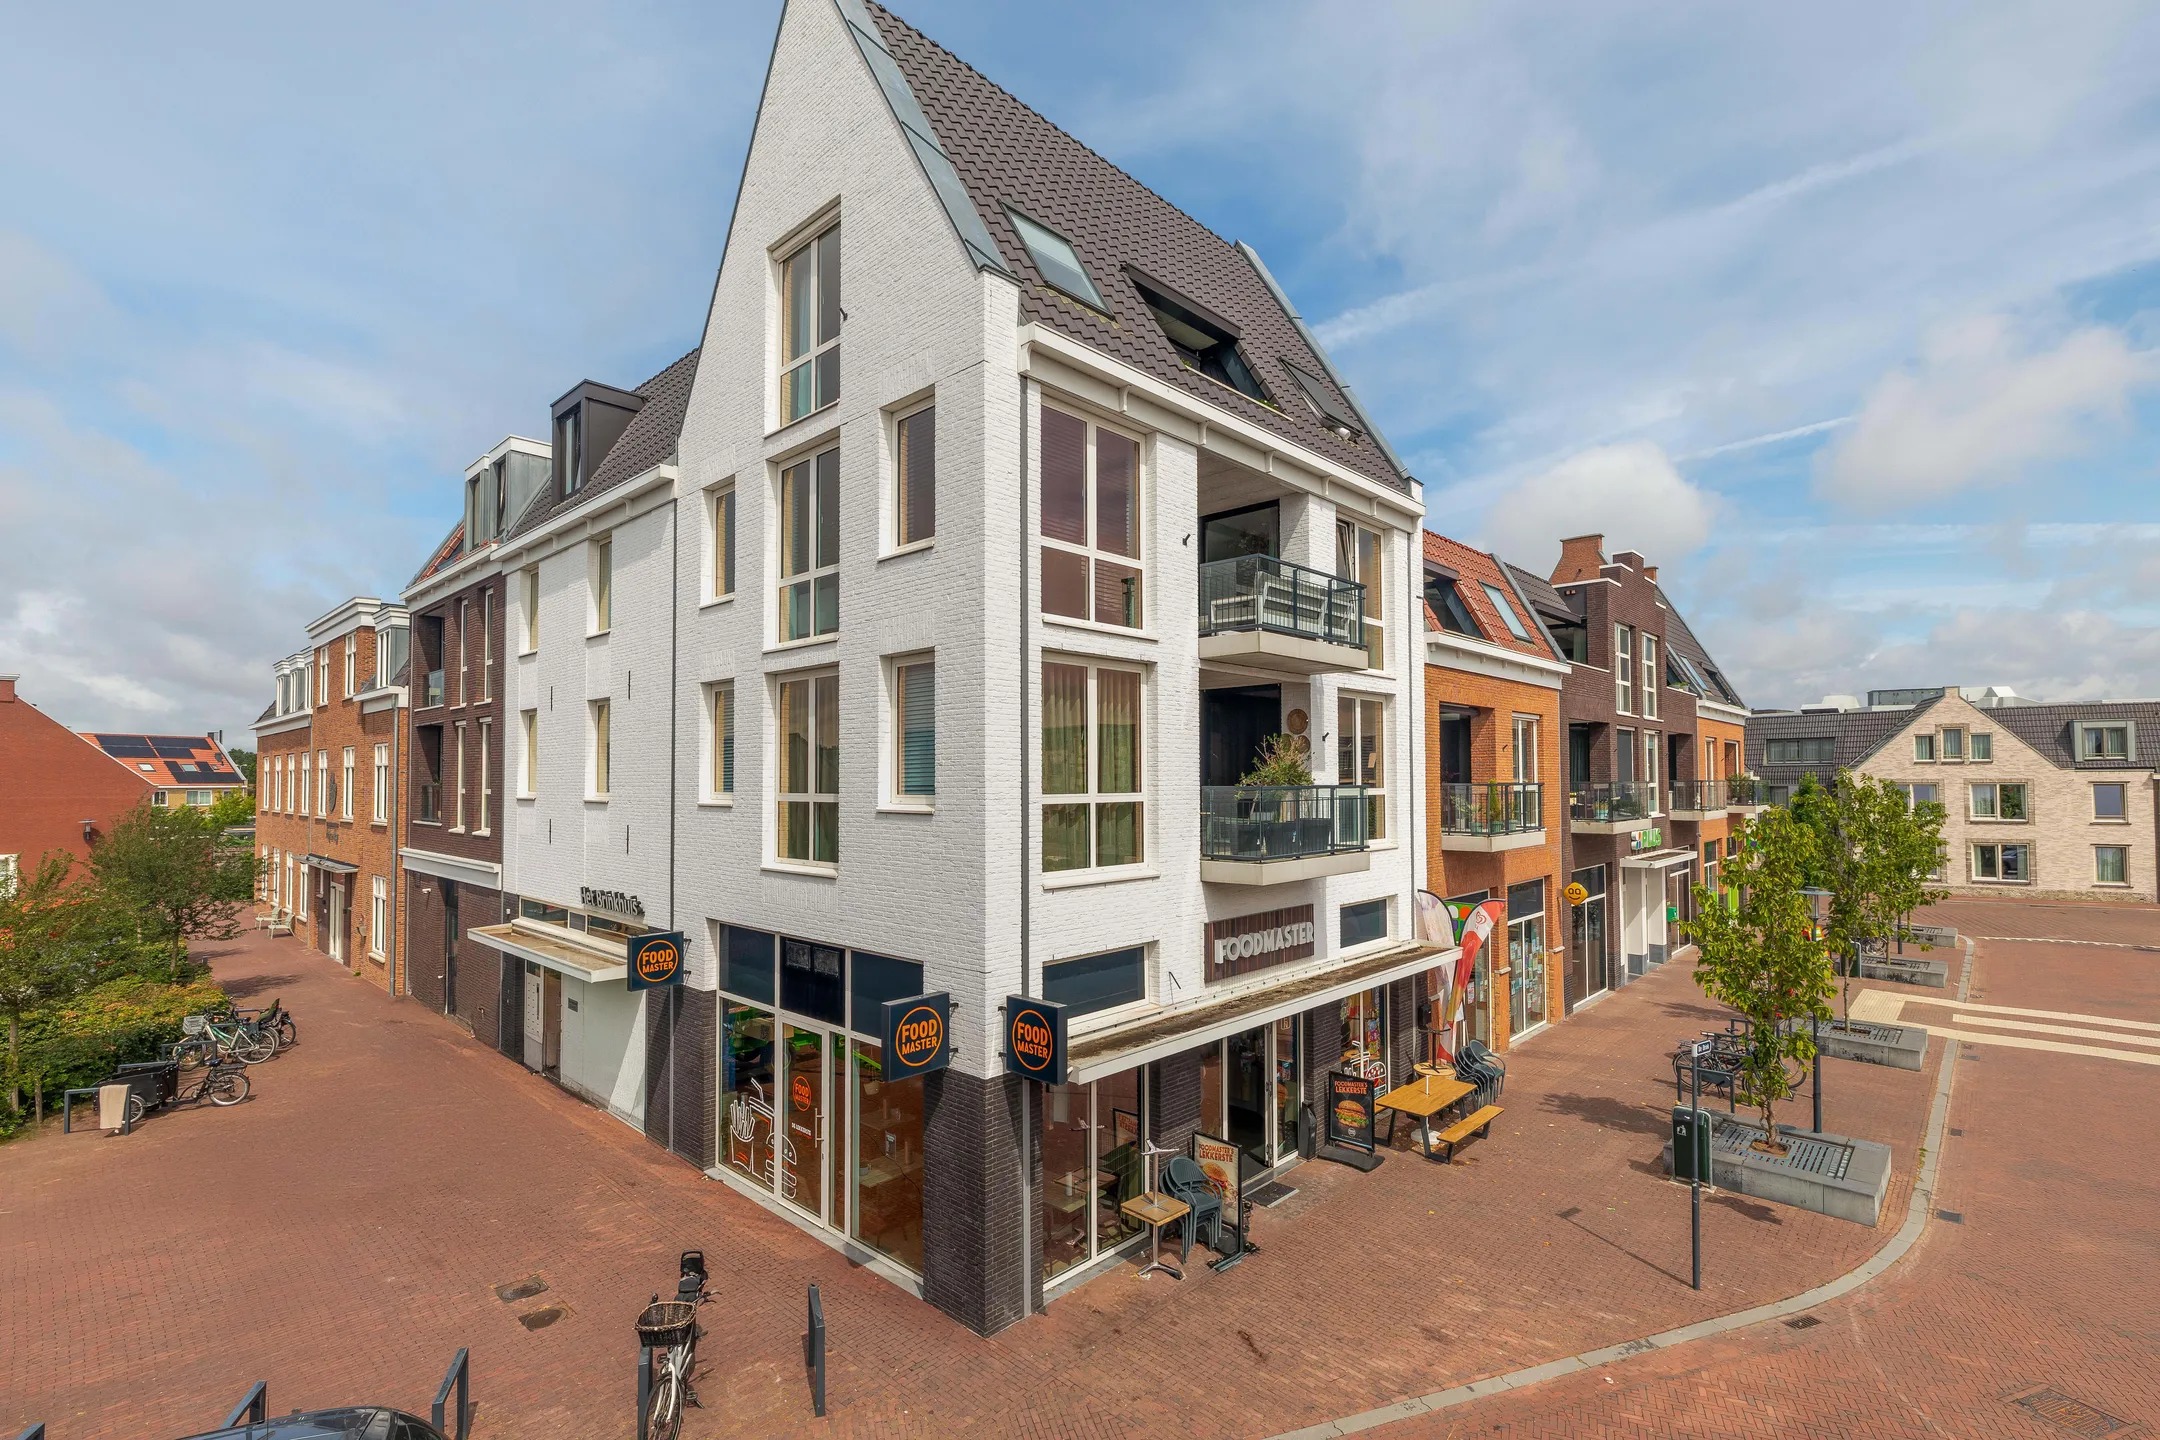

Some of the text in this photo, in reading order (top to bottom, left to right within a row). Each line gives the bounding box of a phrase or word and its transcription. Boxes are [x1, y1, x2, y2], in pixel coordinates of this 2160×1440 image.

[1642, 828, 1661, 848] PLUS
[580, 886, 640, 916] Het Brinkhuis
[1214, 922, 1314, 964] FOODMASTER
[642, 949, 674, 965] FOOD
[642, 961, 674, 974] MASTER
[901, 1019, 938, 1043] FOOD
[1017, 1022, 1049, 1046] FOOD
[901, 1036, 938, 1055] MASTER
[1017, 1039, 1048, 1059] MASTER
[795, 1083, 809, 1097] FOOD
[1334, 1080, 1368, 1088] FOODMASTER'S
[1335, 1087, 1367, 1095] LEKKERSTE
[1198, 1143, 1234, 1155] FOODMASTER'S
[1199, 1149, 1233, 1162] LEKKERSTE
